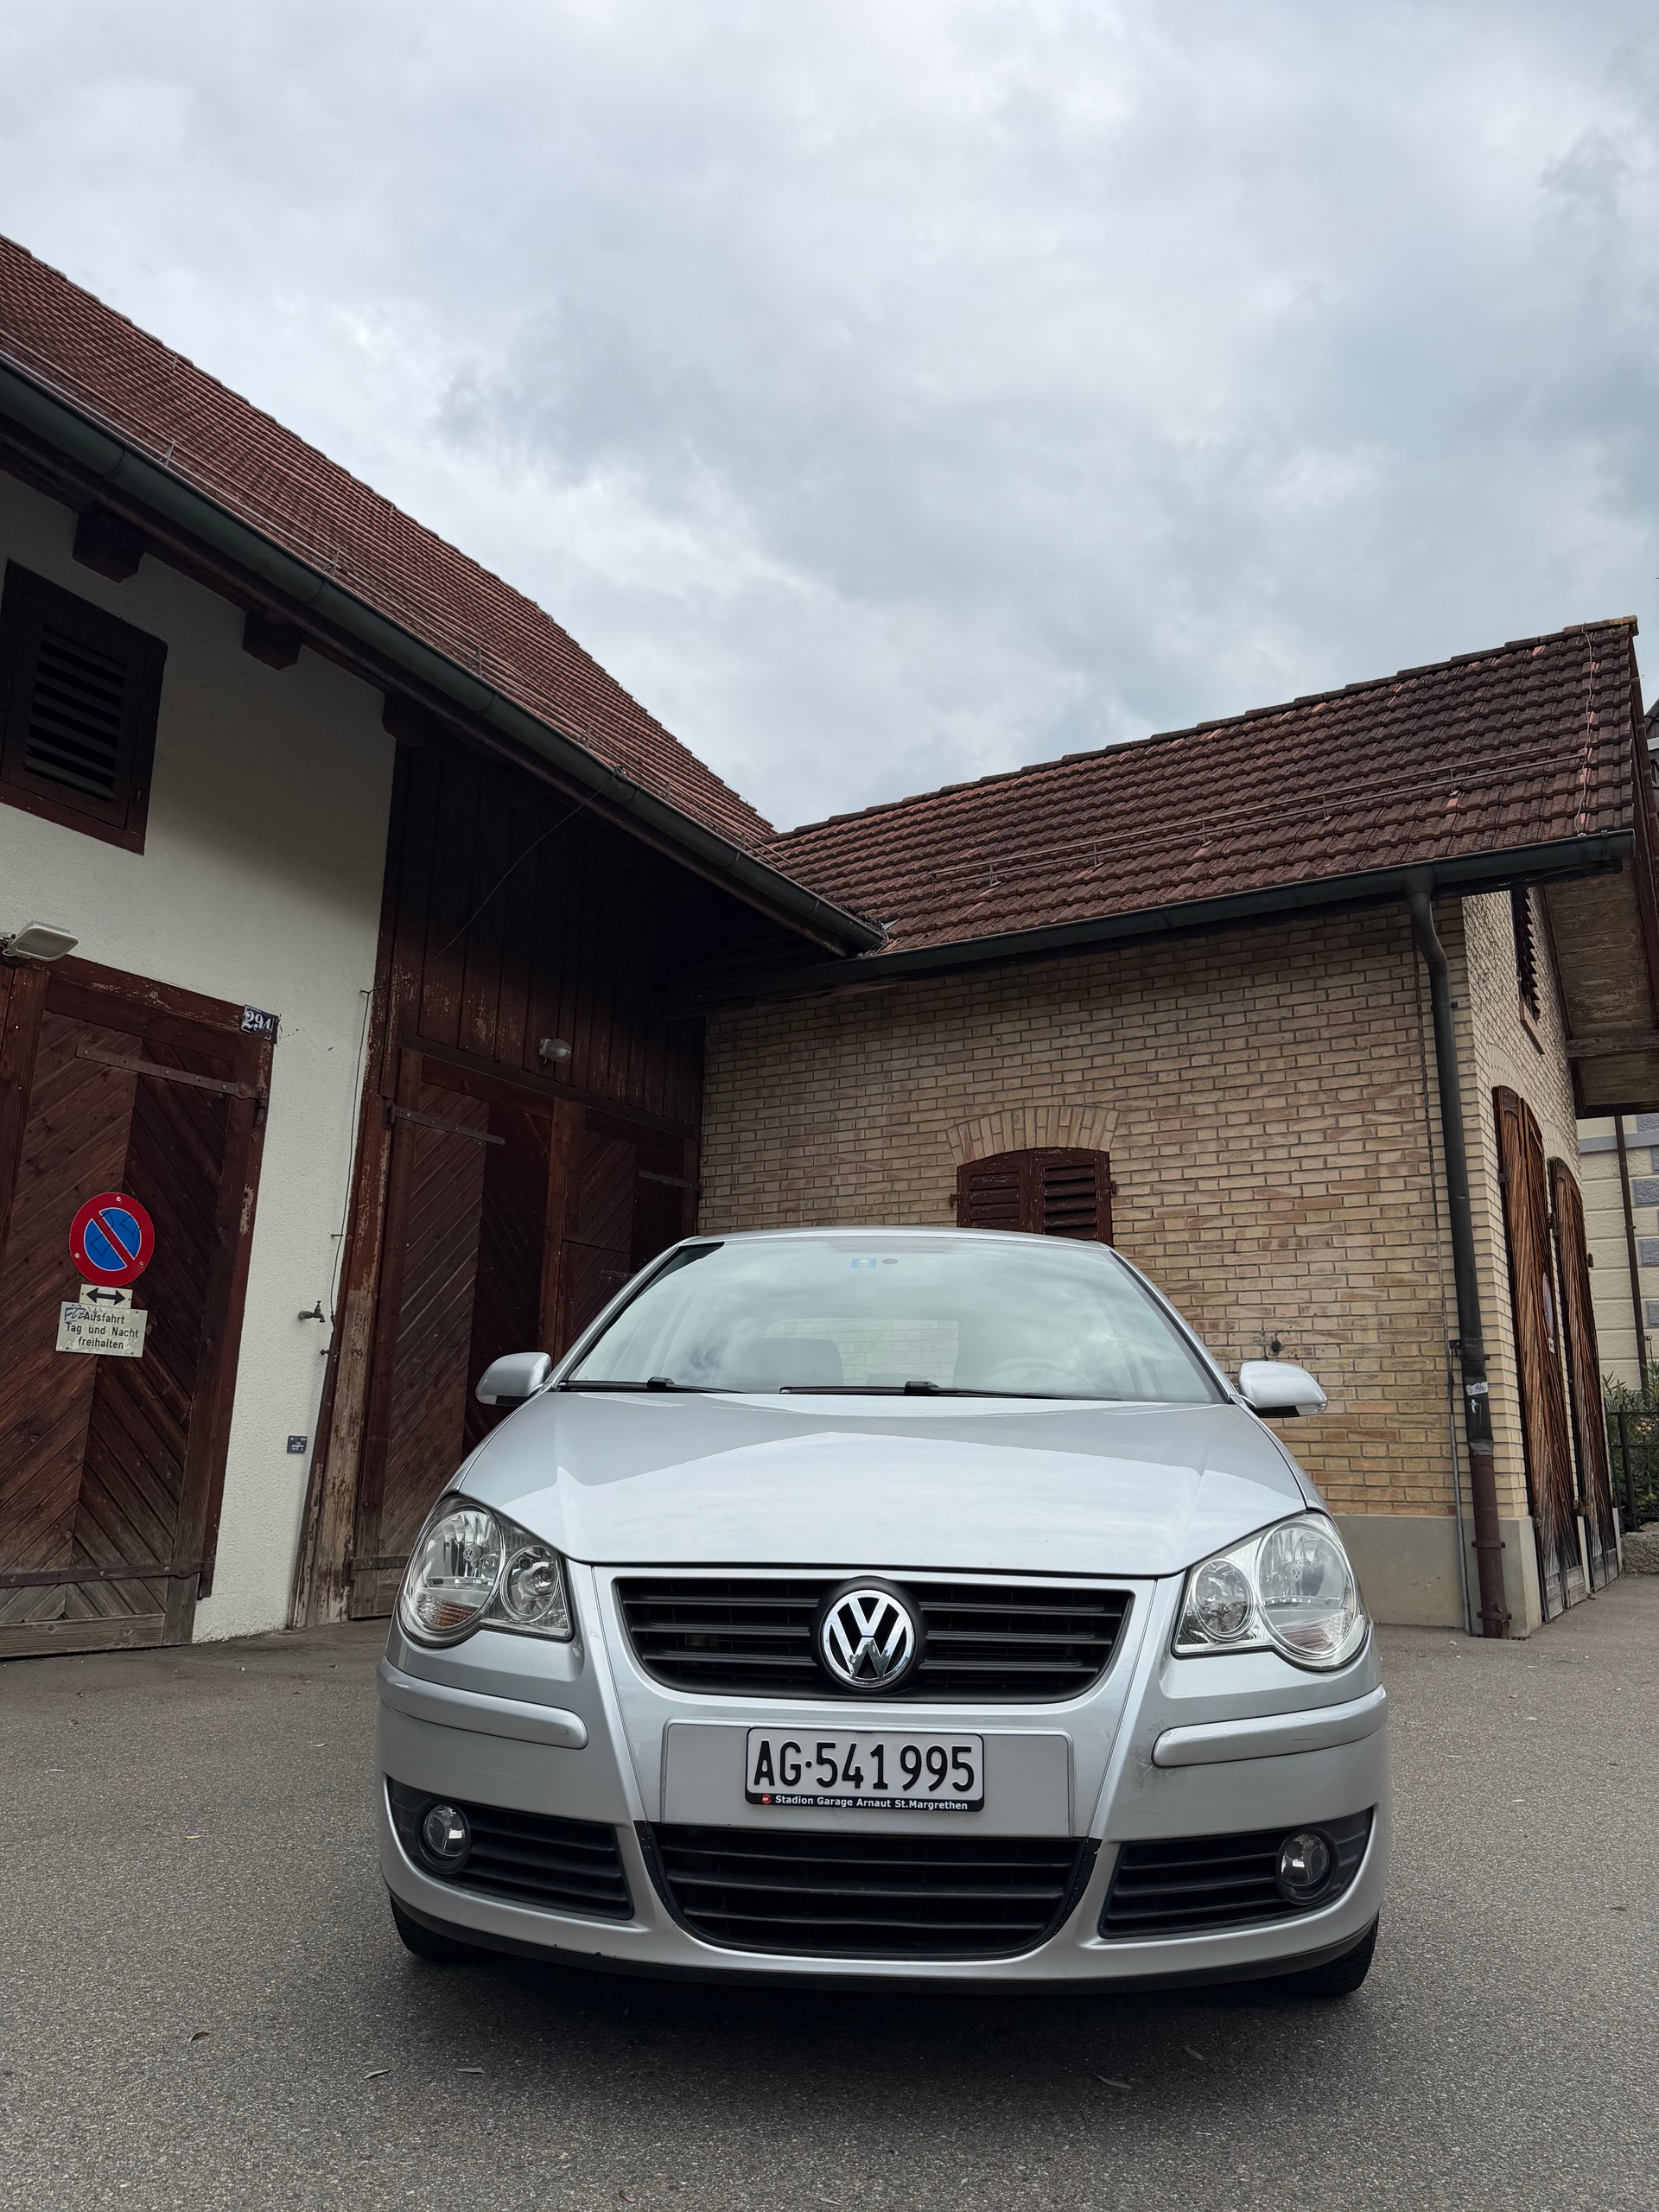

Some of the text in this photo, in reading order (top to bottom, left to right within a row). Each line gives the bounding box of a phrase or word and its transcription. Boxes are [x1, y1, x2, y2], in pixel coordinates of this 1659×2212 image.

[84, 1312, 125, 1325] Ausfahrt
[65, 1321, 139, 1338] Tag und Nacht
[79, 1337, 124, 1350] freihalten
[823, 1590, 914, 1688] VW
[775, 1795, 814, 1805] Stadion
[817, 1796, 854, 1808] Garage
[855, 1798, 892, 1808] Arnaut
[894, 1799, 969, 1811] St.Margrethen
